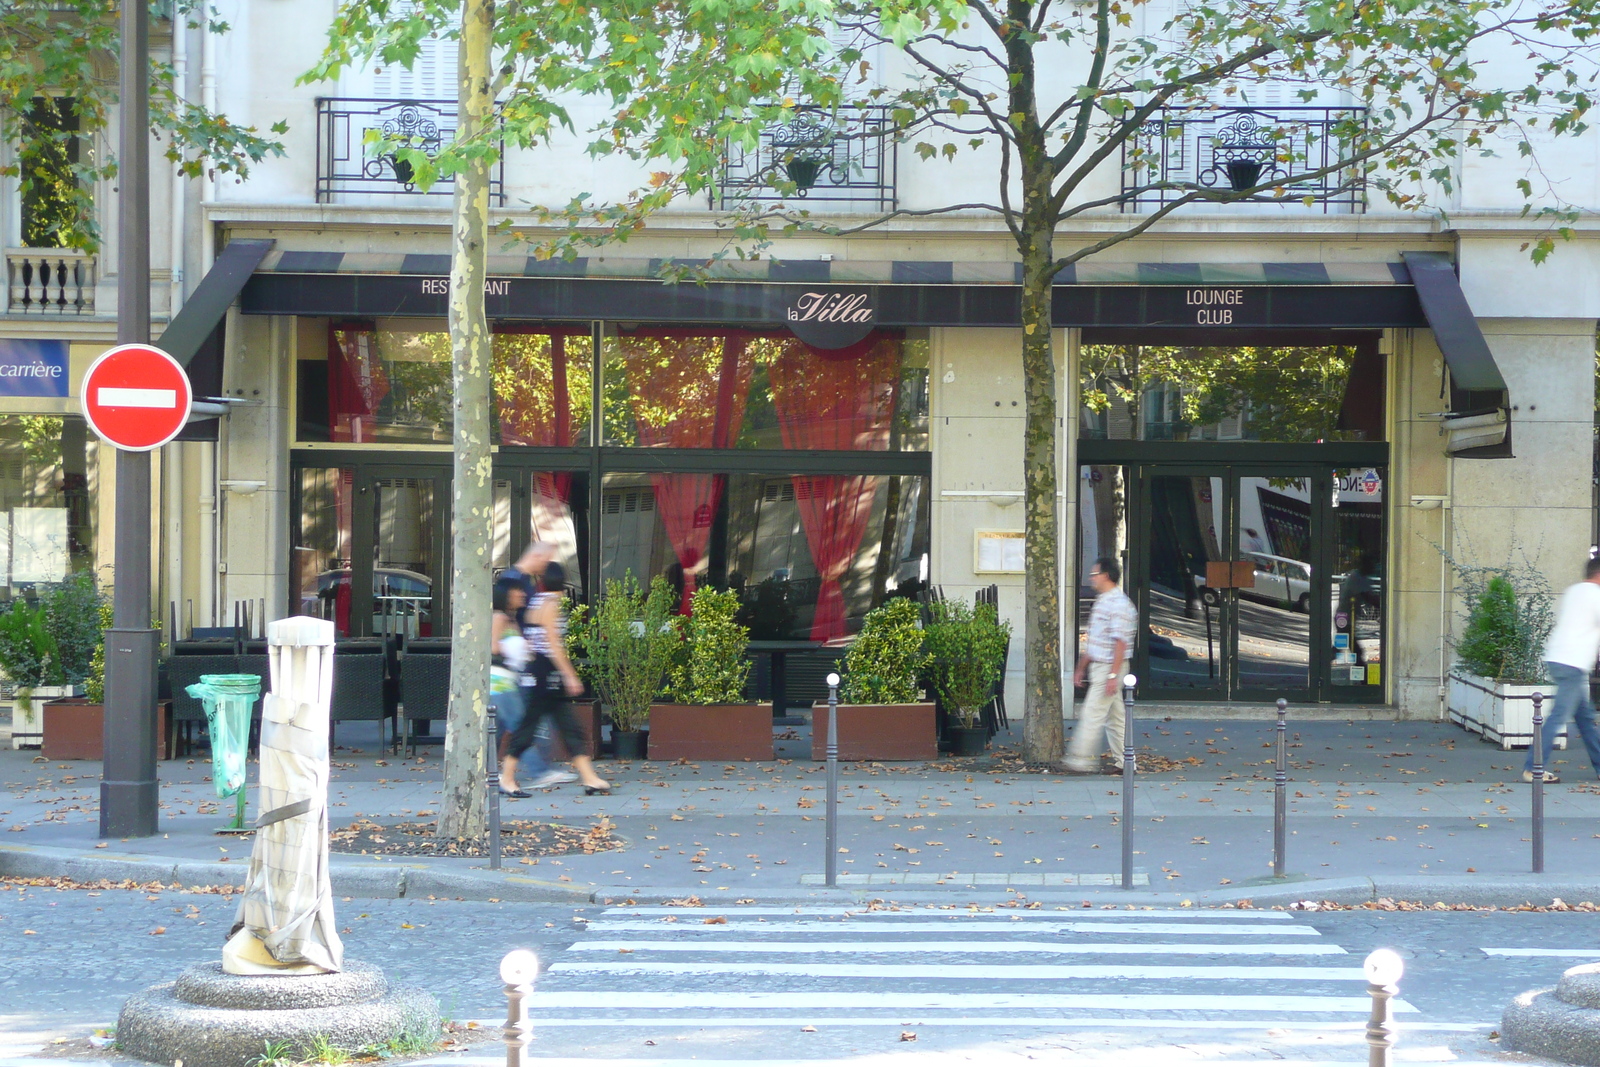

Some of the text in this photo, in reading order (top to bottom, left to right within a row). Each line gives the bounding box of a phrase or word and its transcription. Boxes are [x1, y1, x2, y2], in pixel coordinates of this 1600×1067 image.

[422, 280, 511, 295] RESANT
[1186, 289, 1243, 305] LOUNGE
[787, 292, 873, 323] la Villa
[1197, 309, 1233, 325] CLUB
[0, 360, 62, 378] carrière
